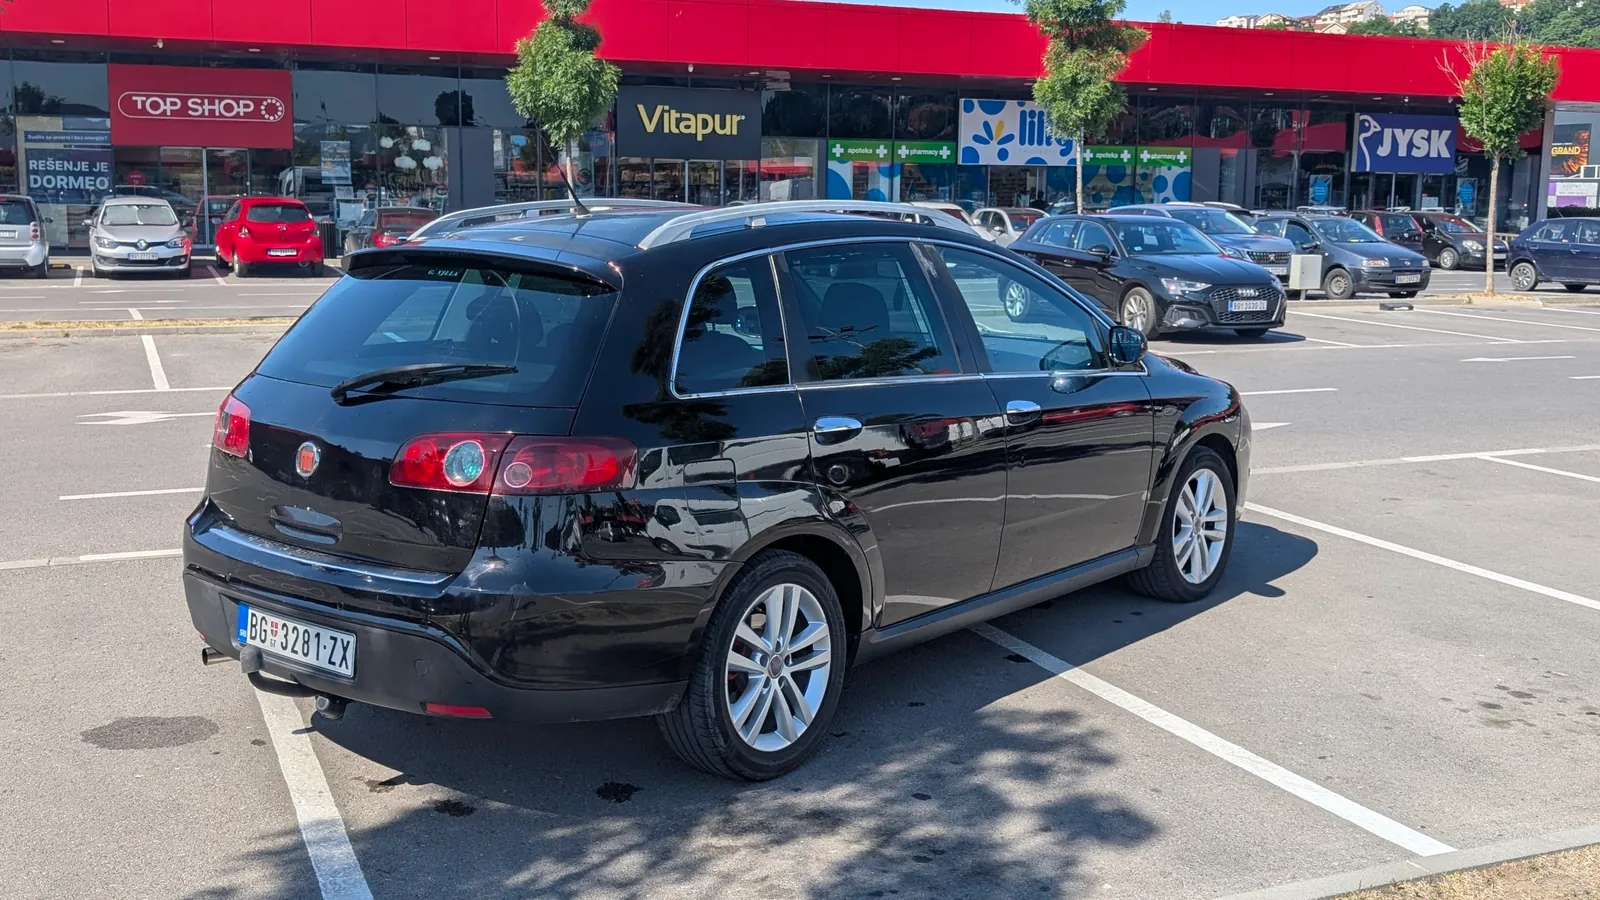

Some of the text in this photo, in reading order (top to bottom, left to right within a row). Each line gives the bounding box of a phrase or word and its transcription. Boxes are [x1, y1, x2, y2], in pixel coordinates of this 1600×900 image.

[132, 96, 254, 117] TOP SHOP
[636, 104, 742, 141] Vitapur
[1376, 128, 1451, 158] JYSK
[909, 147, 939, 156] pharmacy
[1151, 153, 1176, 161] pharmacy
[1551, 146, 1581, 155] GRAND
[29, 158, 109, 172] REŠENJE JE
[29, 175, 109, 189] DORMEO
[249, 612, 268, 643] BG
